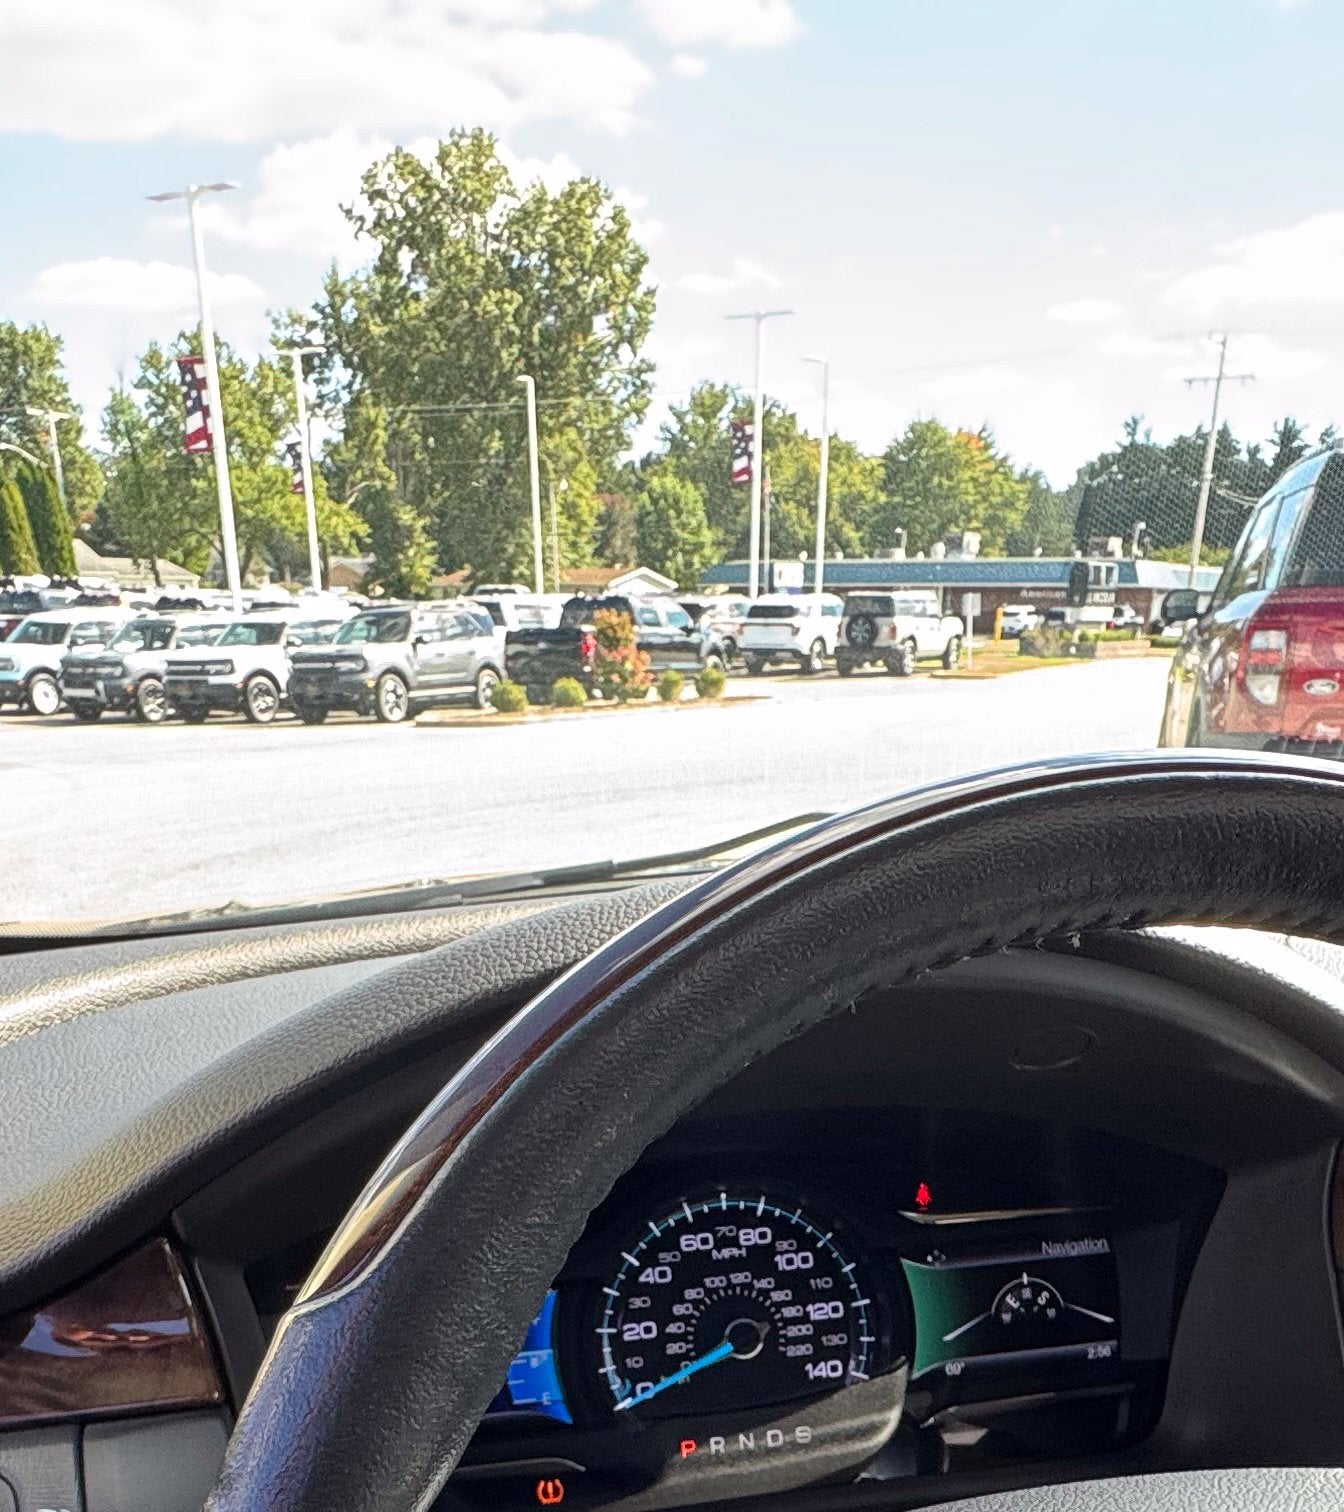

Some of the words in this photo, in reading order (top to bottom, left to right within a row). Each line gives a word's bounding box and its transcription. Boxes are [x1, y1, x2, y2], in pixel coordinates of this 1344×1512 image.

[715, 1225, 737, 1238] 70
[738, 1227, 772, 1246] 80
[679, 1232, 714, 1251] 60
[1041, 1236, 1110, 1256] Navigation
[658, 1251, 681, 1263] 50
[712, 1247, 747, 1260] MPH
[774, 1251, 814, 1271] 100
[638, 1266, 672, 1284] 40
[704, 1275, 727, 1288] 100
[729, 1271, 752, 1284] 120
[752, 1277, 775, 1289] 140
[809, 1277, 833, 1290] 110
[628, 1296, 651, 1309] 30
[672, 1303, 693, 1316] 60
[806, 1301, 844, 1321] 120
[622, 1320, 657, 1341] 20
[665, 1321, 686, 1334] 40
[786, 1324, 814, 1337] 200
[821, 1333, 848, 1347] 130
[625, 1356, 644, 1369] 10
[805, 1359, 843, 1380] 140
[680, 1439, 697, 1459] P
[710, 1436, 726, 1456] R
[738, 1432, 755, 1450] N
[766, 1428, 784, 1448] D
[795, 1425, 812, 1444] S
